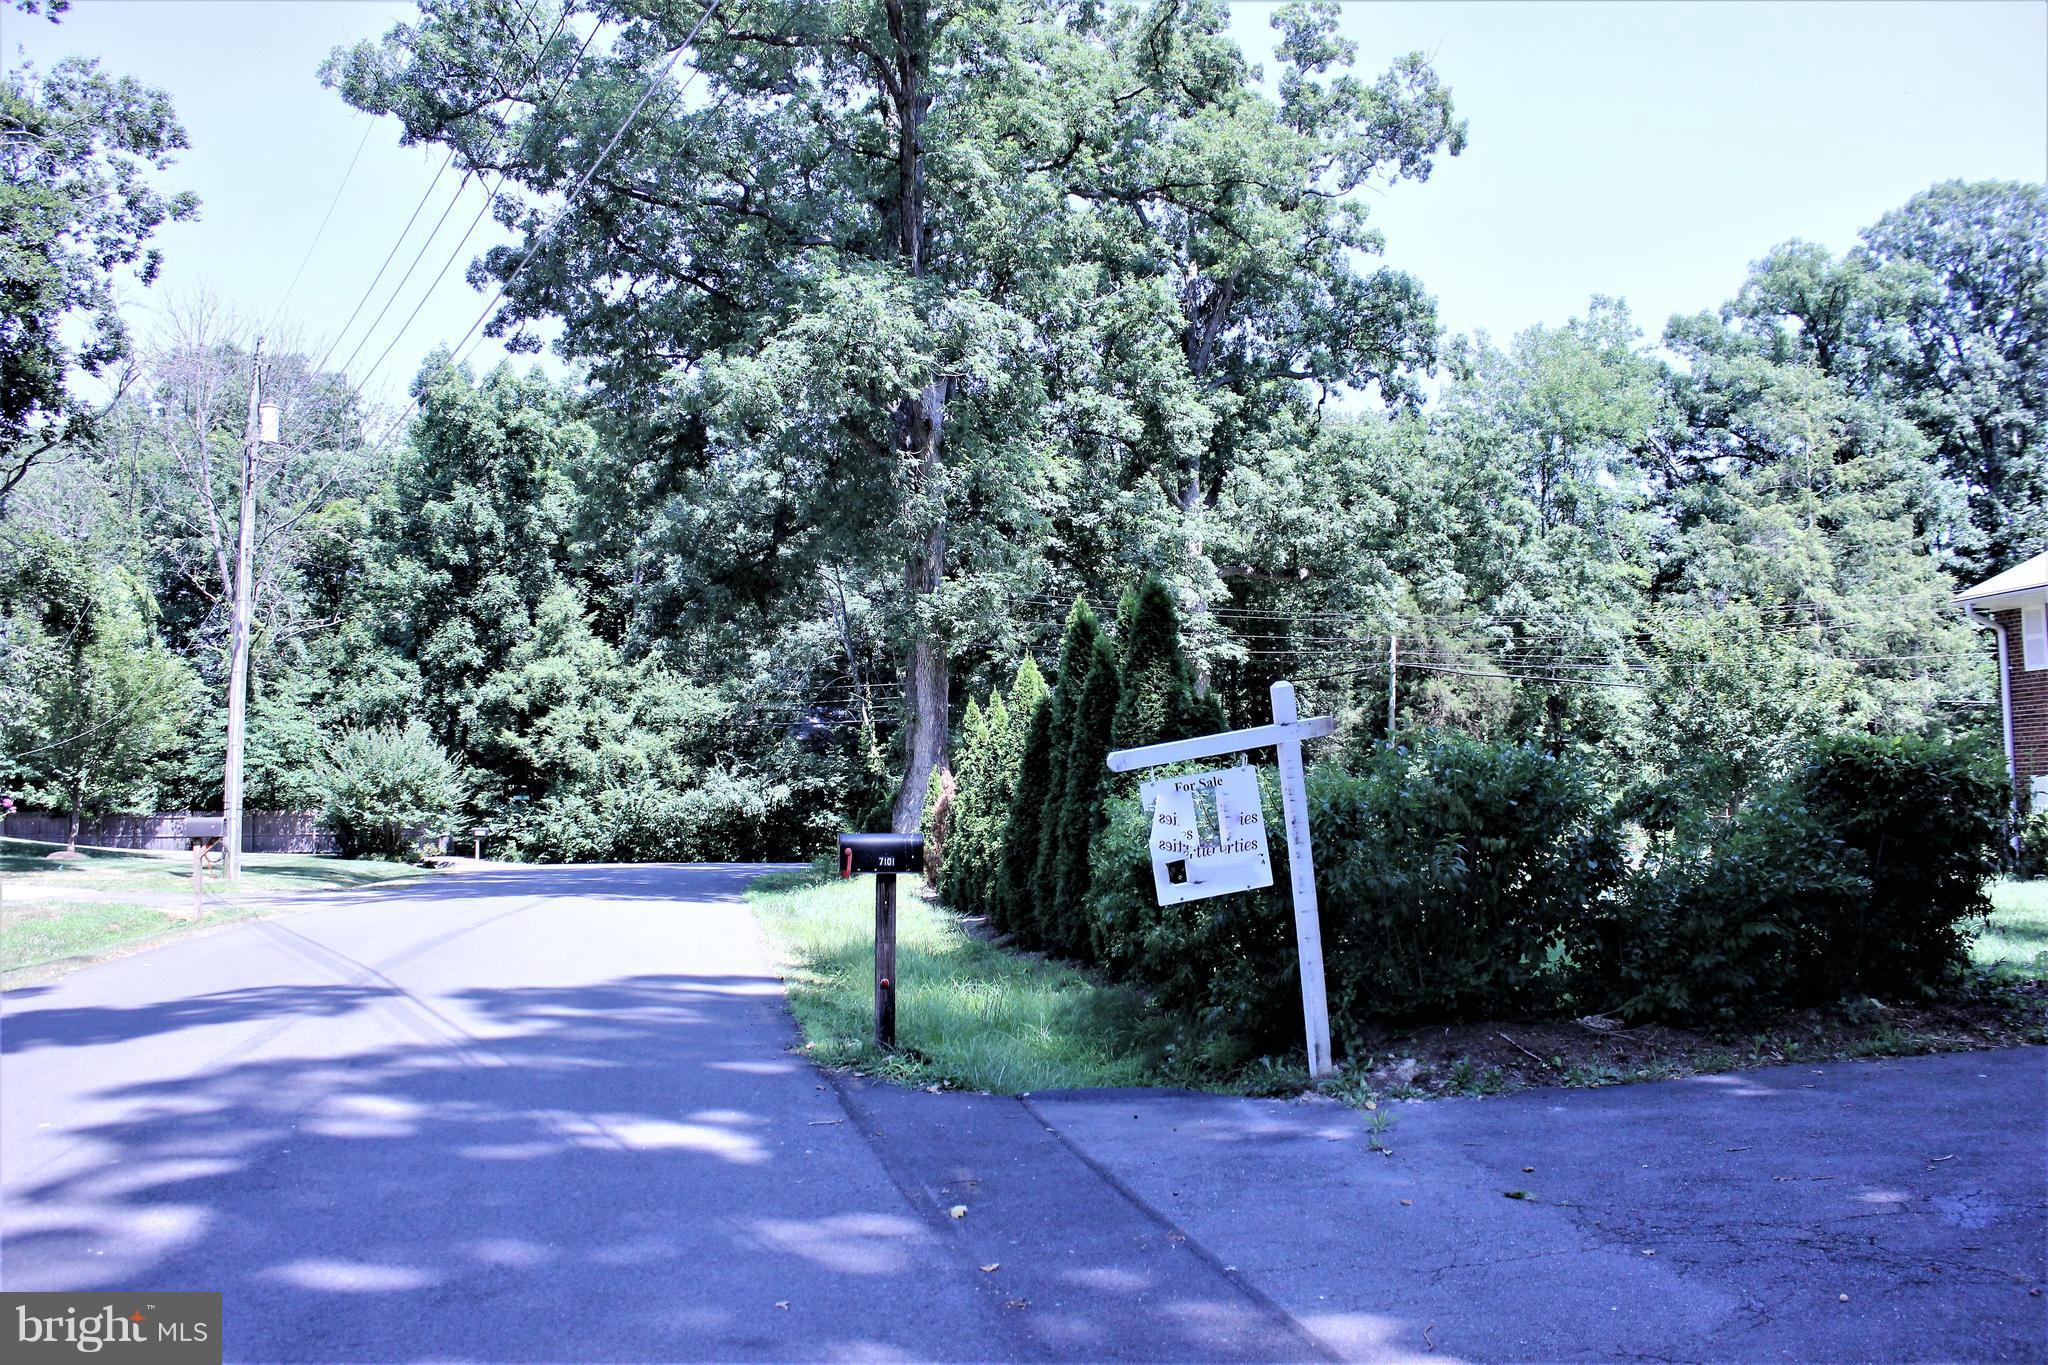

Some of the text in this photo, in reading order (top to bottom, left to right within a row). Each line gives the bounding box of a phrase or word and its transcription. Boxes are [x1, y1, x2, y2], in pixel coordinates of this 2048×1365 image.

[1174, 776, 1223, 792] For Sale
[879, 857, 895, 866] 7101
